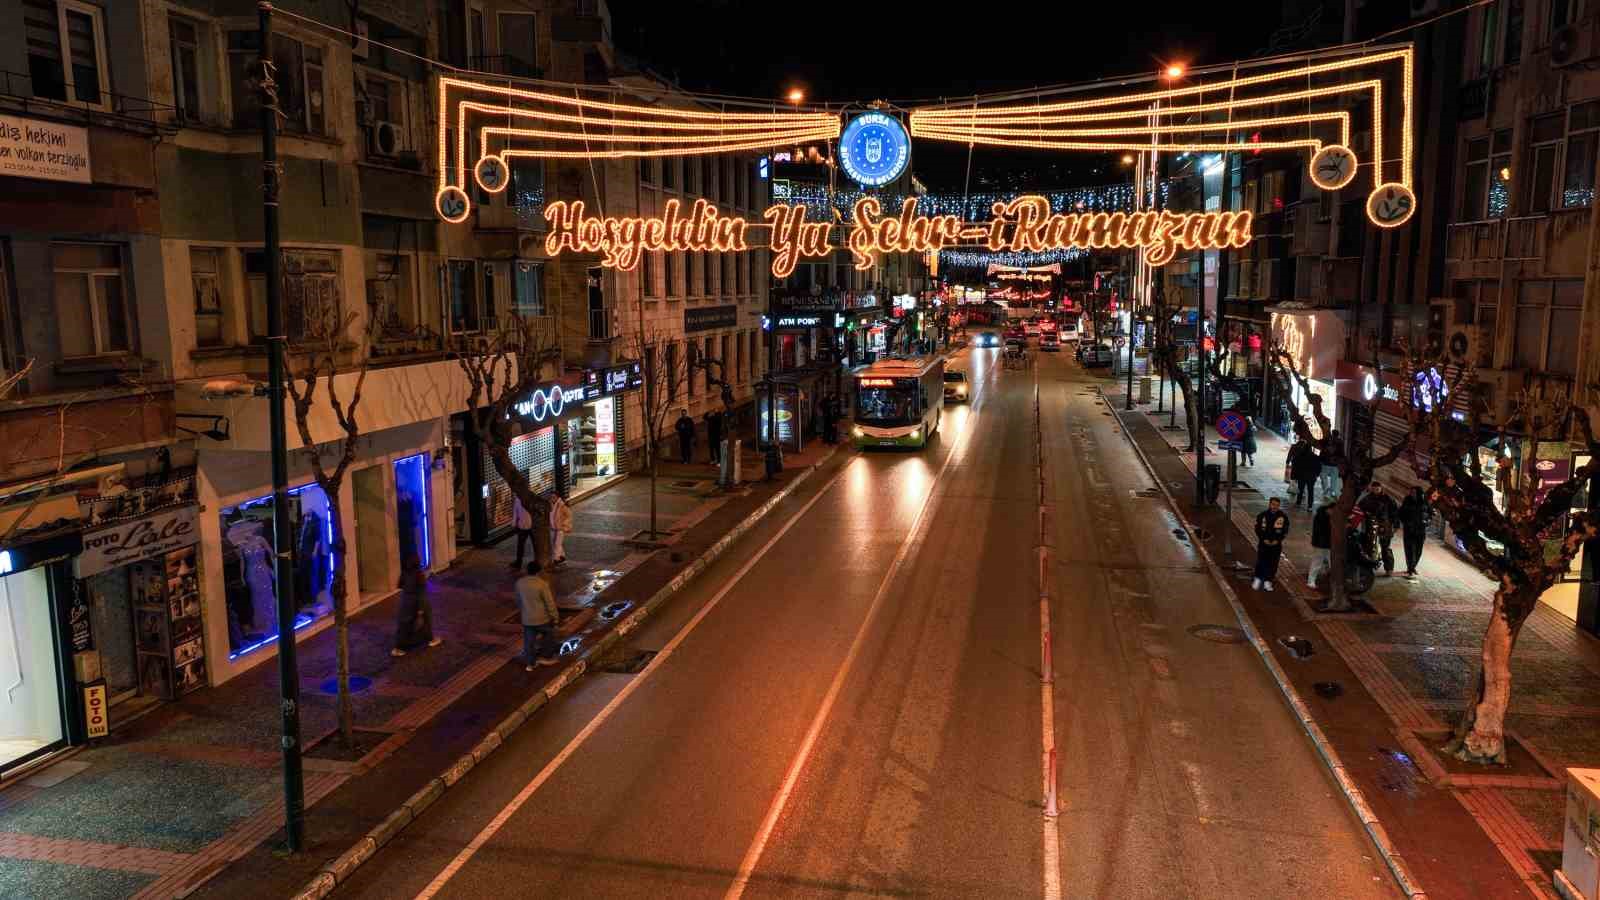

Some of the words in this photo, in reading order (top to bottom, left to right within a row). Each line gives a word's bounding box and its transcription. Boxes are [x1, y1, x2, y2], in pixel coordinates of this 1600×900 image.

[858, 114, 890, 127] BURSA
[15, 145, 45, 161] volkan
[544, 198, 749, 271] Hoşgeldin
[764, 202, 833, 279] Ya
[778, 318, 795, 326] ATM
[85, 532, 119, 550] FOTO
[90, 688, 105, 724] FOTO
